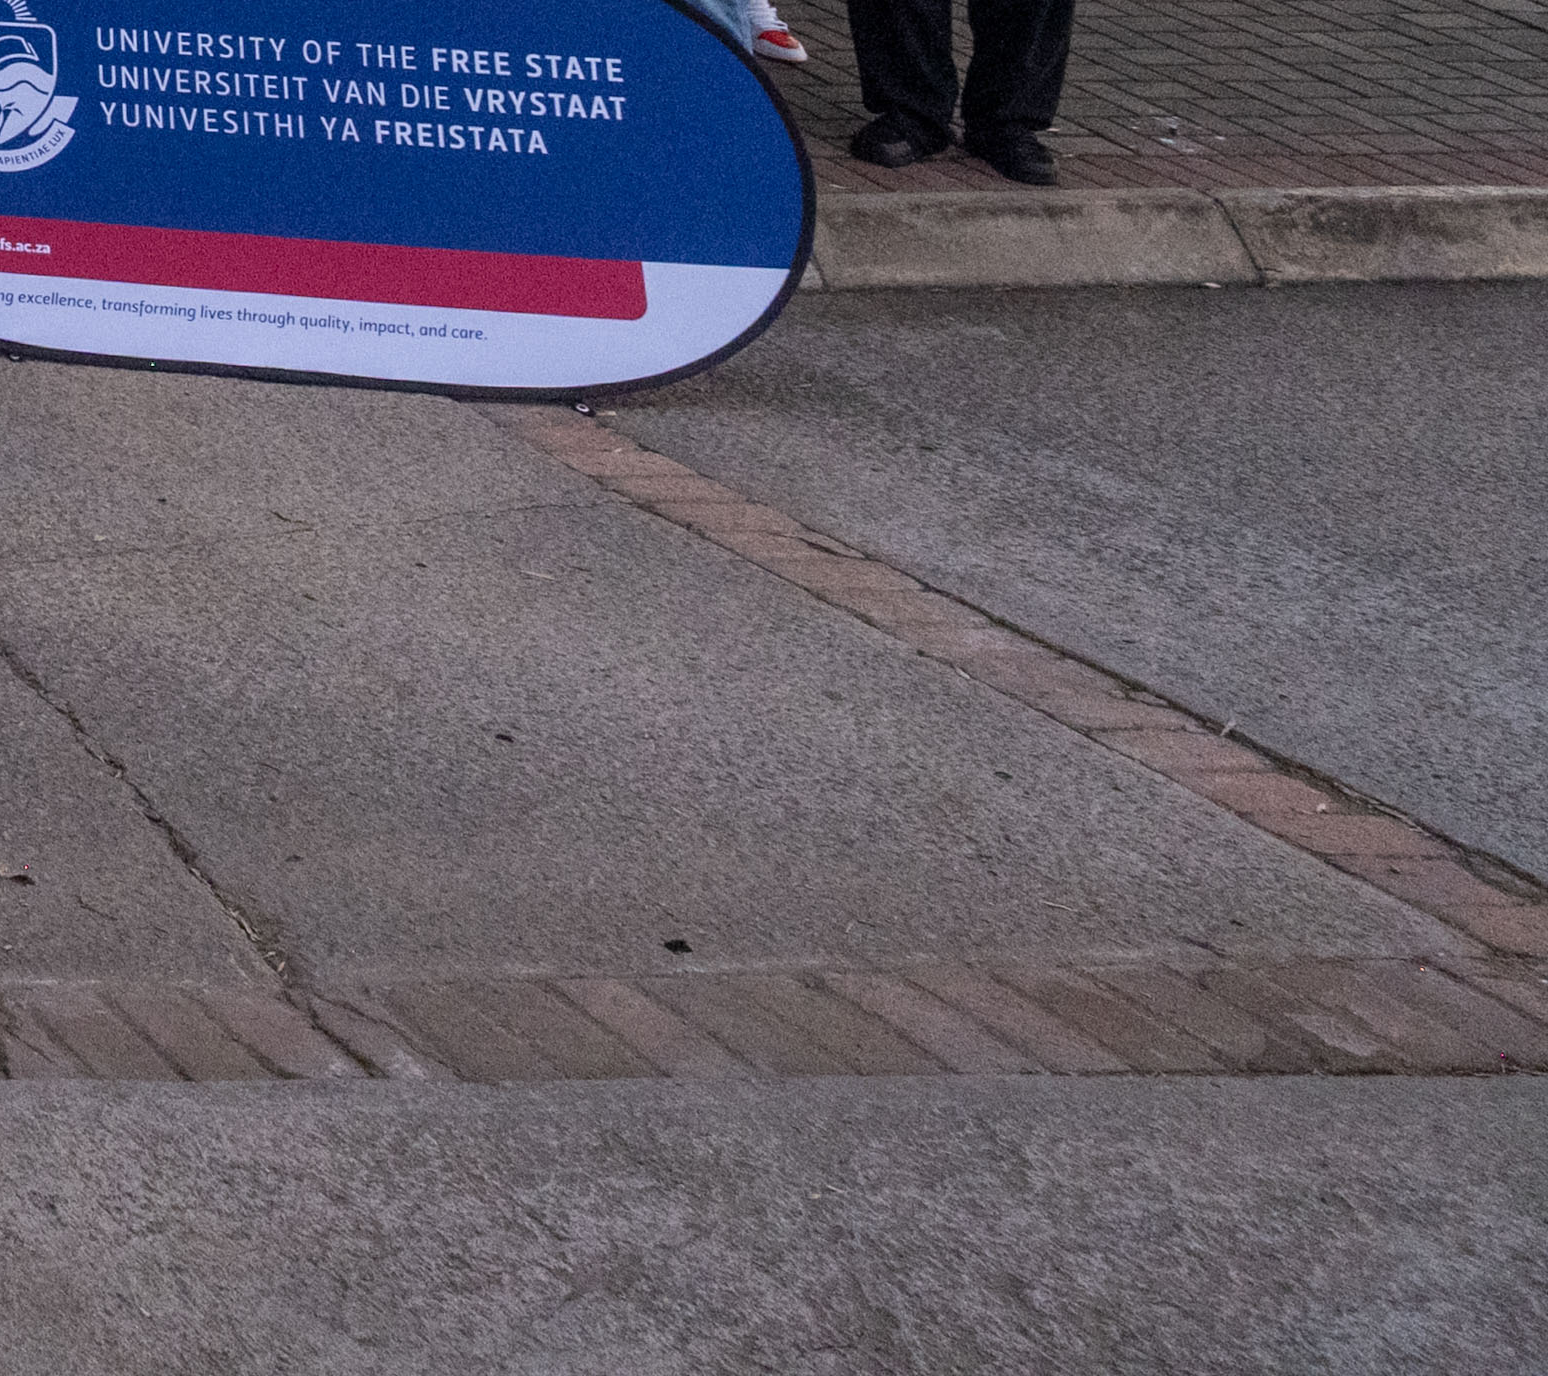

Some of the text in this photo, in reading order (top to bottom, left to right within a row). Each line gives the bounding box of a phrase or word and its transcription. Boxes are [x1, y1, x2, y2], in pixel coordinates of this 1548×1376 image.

[96, 26, 625, 83] UNIVERSITY OF THE FREE STATE
[98, 64, 627, 121] UNIVERSITEIT VAN DIE VRYSTAAT
[48, 128, 67, 147] LUX
[100, 101, 549, 155] YUNIVESITHI YA FREISTATA
[18, 292, 97, 311] excellence,
[101, 297, 196, 322] transforming
[200, 305, 233, 321] lives
[237, 307, 296, 329] through
[299, 315, 355, 334] quality,
[358, 317, 416, 338] impact,
[419, 324, 448, 338] and
[451, 326, 489, 341] care.
